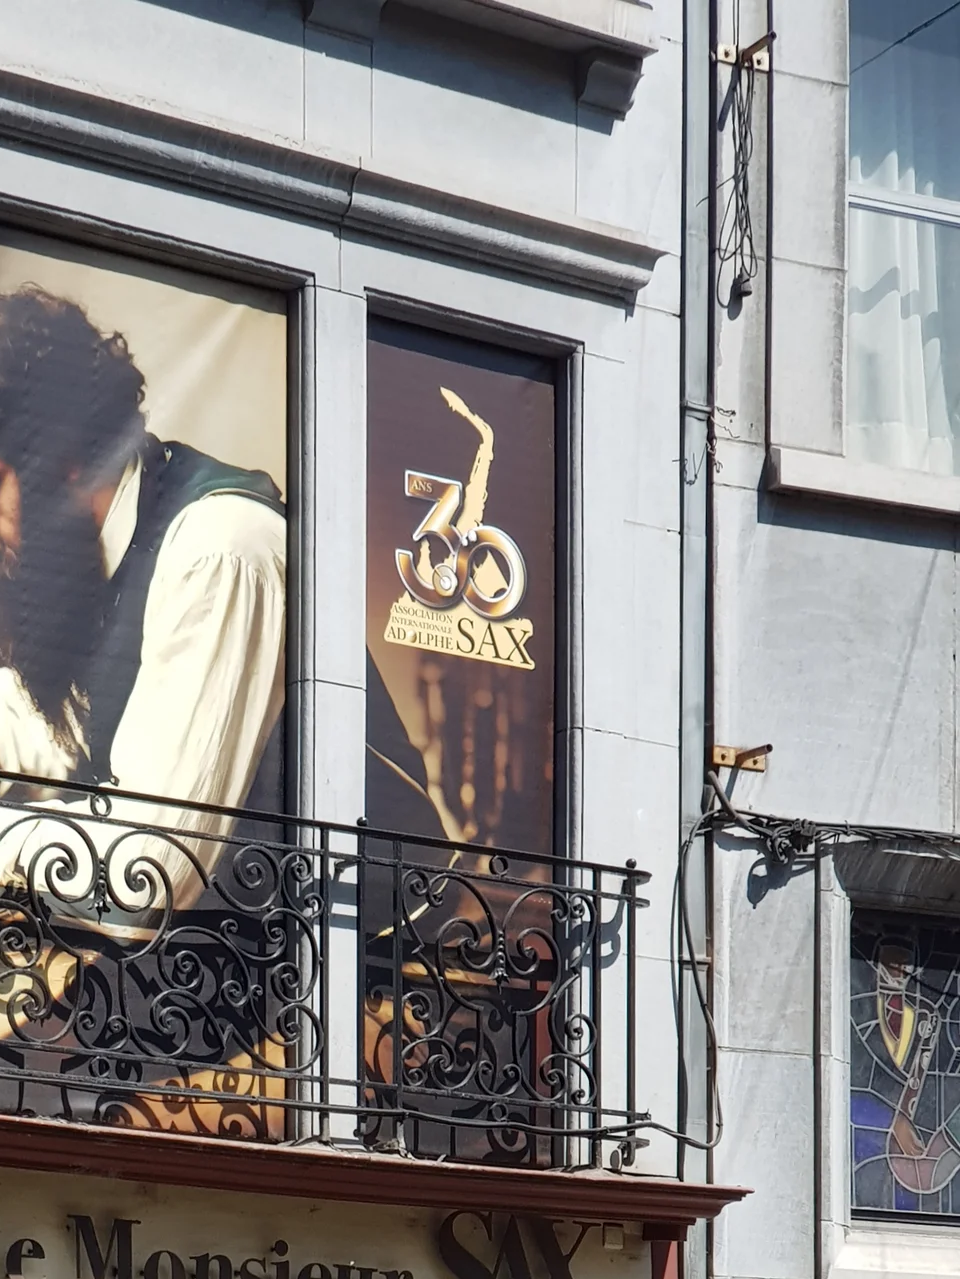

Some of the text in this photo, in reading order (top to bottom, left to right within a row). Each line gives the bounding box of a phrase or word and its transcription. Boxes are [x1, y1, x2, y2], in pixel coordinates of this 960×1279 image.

[411, 477, 433, 493] ANS
[392, 604, 453, 624] ASSOCIATION
[391, 615, 453, 635] INTERNATIONALE
[456, 617, 533, 666] SAX
